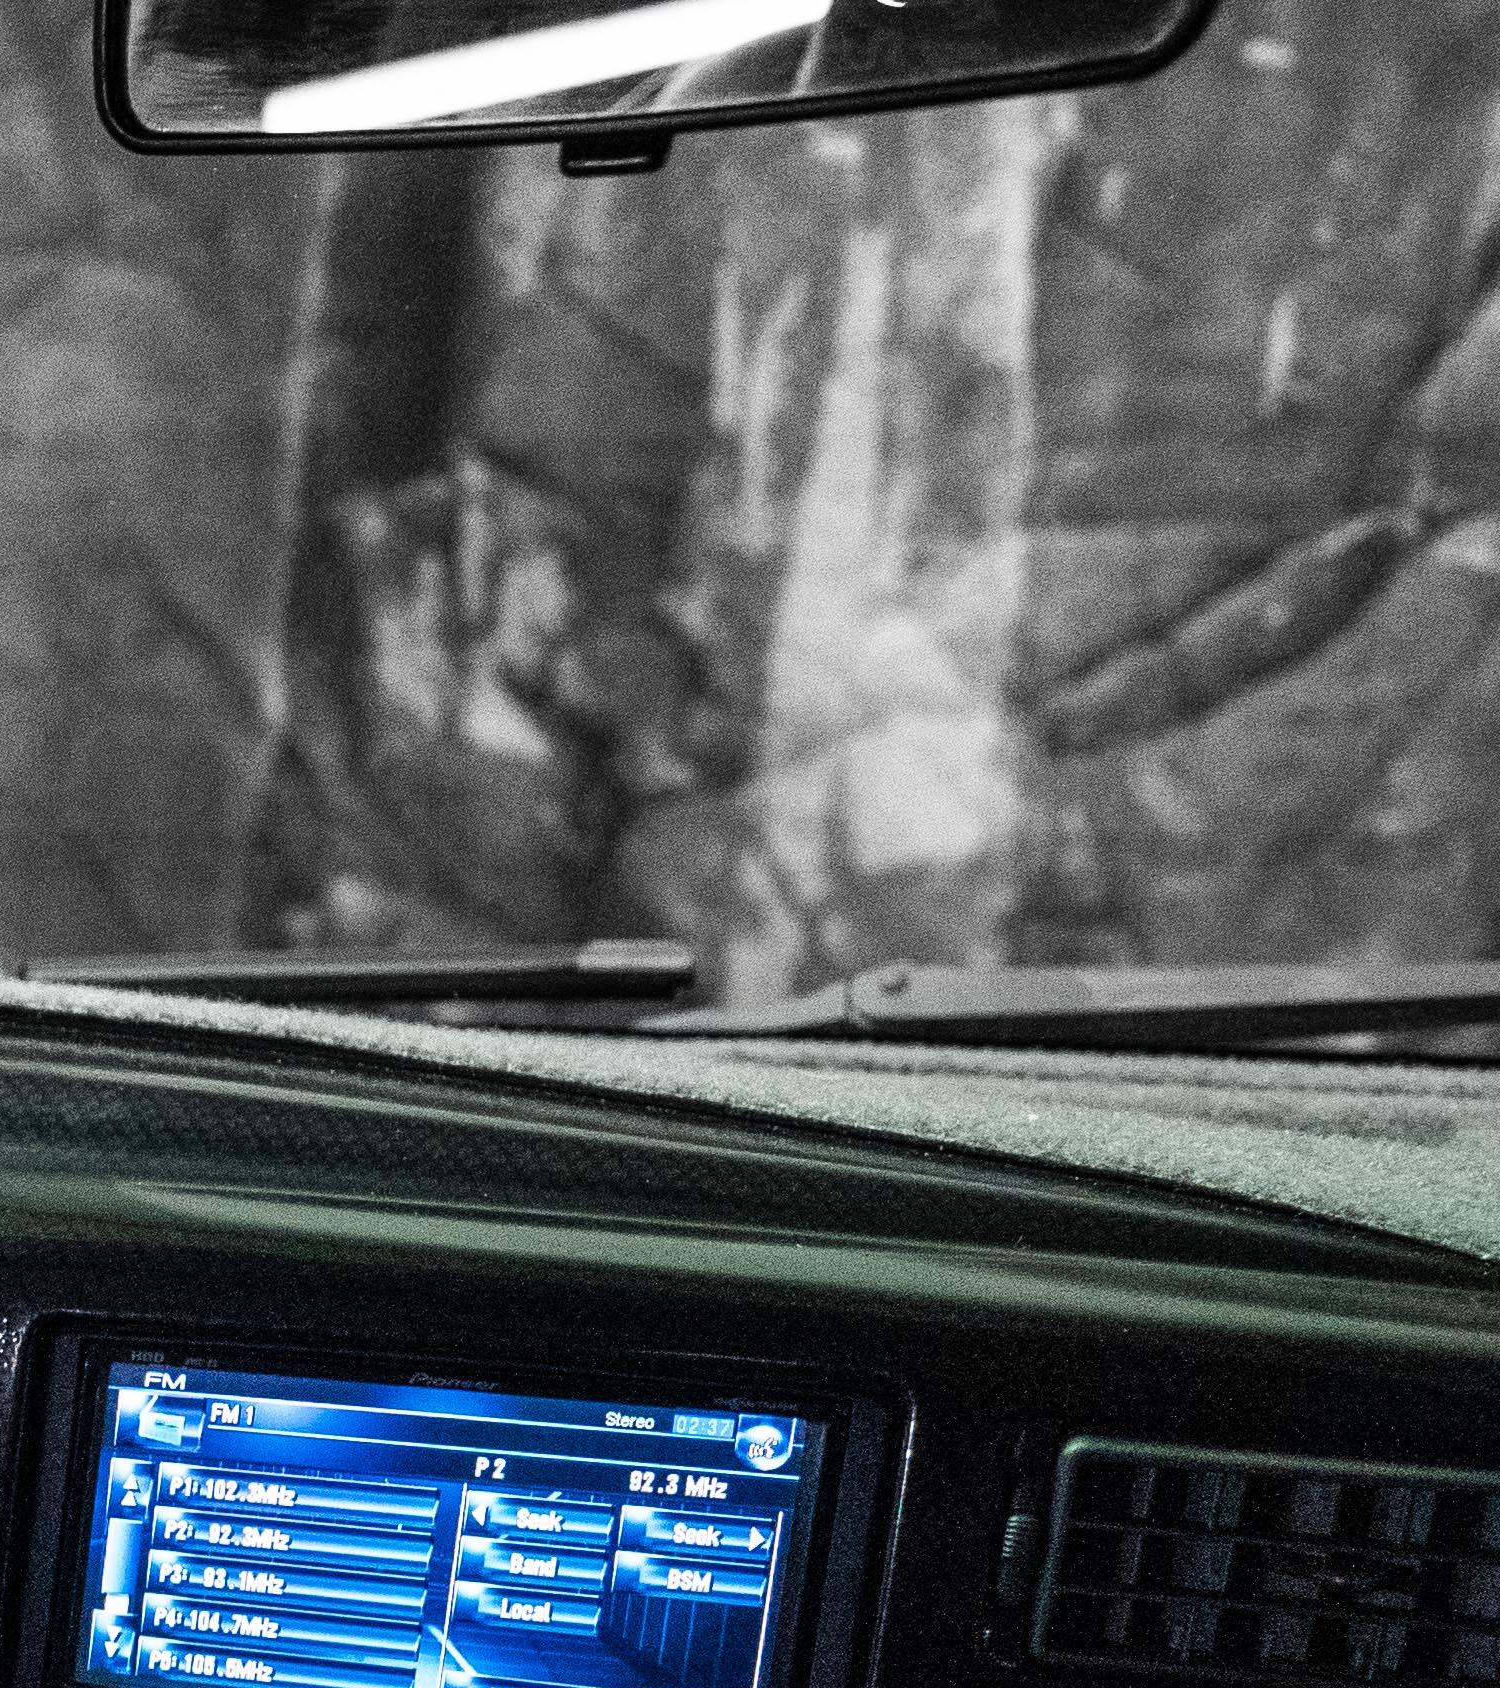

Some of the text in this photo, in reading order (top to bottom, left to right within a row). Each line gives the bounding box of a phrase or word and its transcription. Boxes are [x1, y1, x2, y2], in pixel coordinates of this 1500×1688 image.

[144, 1372, 186, 1390] FM
[211, 1402, 254, 1425] FM 1
[605, 1411, 655, 1429] Stereo
[677, 1418, 733, 1437] 02:37
[169, 1477, 198, 1497] P1:
[630, 1470, 728, 1499] 92.3 MHz
[165, 1520, 193, 1541] P2:
[516, 1508, 564, 1532] Seek
[673, 1523, 722, 1547] Seek
[159, 1563, 187, 1583] P3:
[509, 1553, 557, 1578] Band
[667, 1569, 713, 1593] BSM
[154, 1606, 182, 1628] P4:
[500, 1598, 551, 1622] Local
